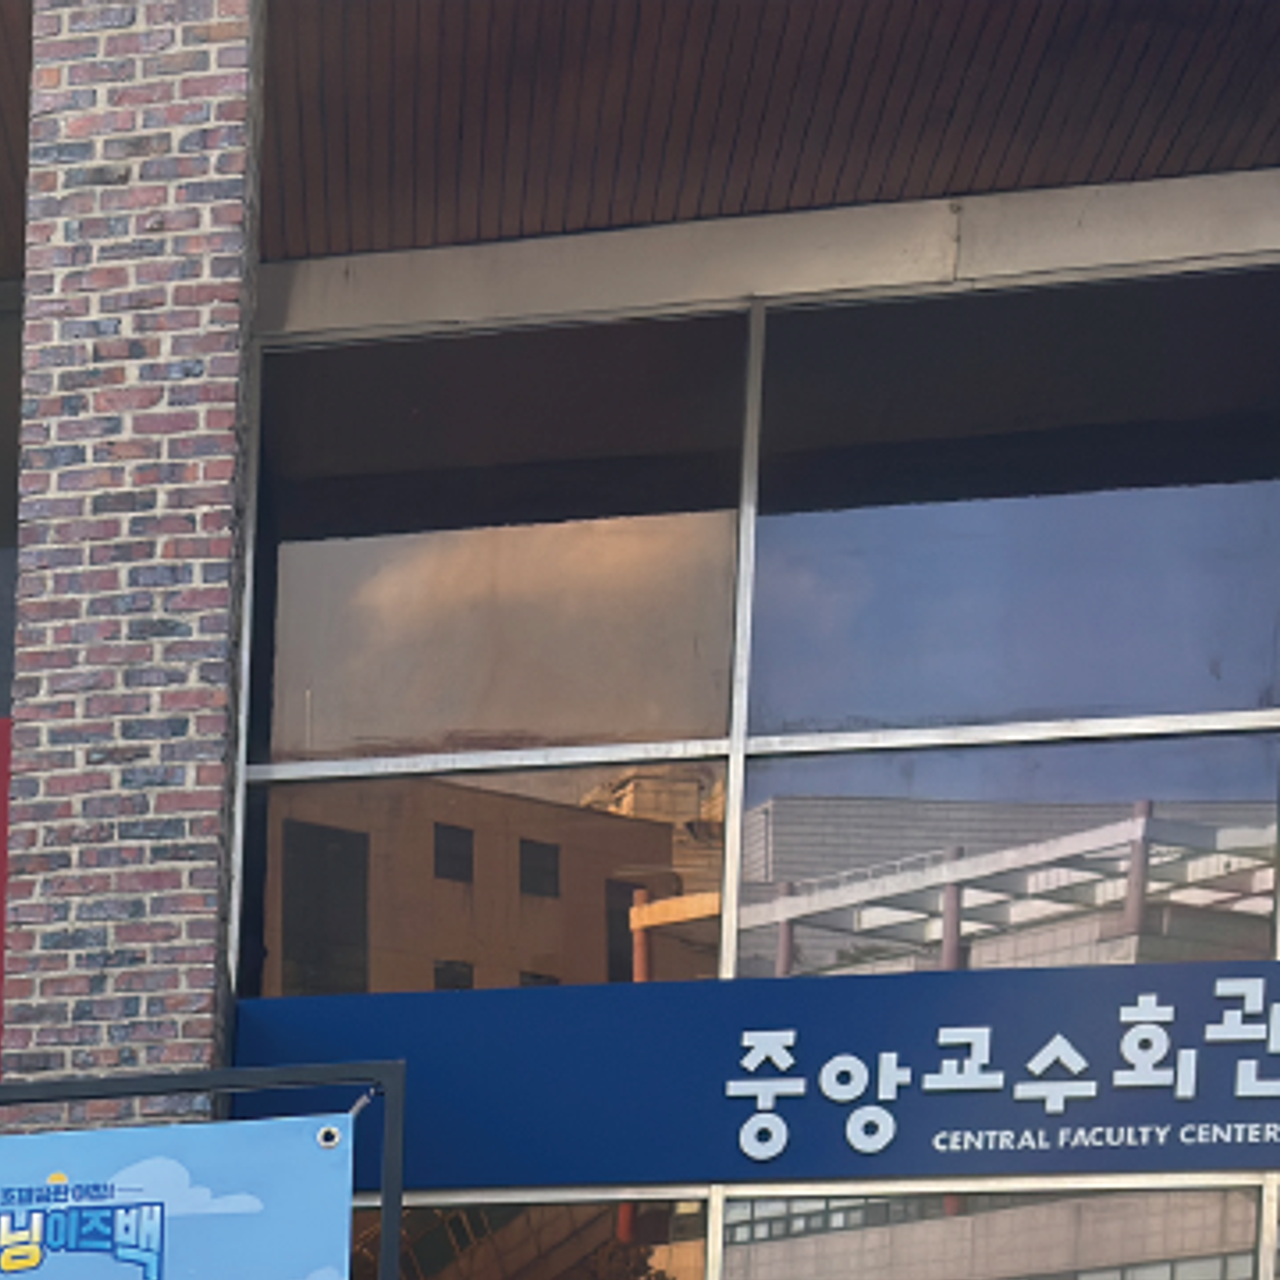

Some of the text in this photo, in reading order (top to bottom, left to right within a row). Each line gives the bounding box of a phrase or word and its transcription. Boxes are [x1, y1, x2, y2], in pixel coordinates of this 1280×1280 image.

[726, 978, 1280, 1160] 중앙교수회관
[932, 1123, 1280, 1151] CENTRAL FACULTY CENTER
